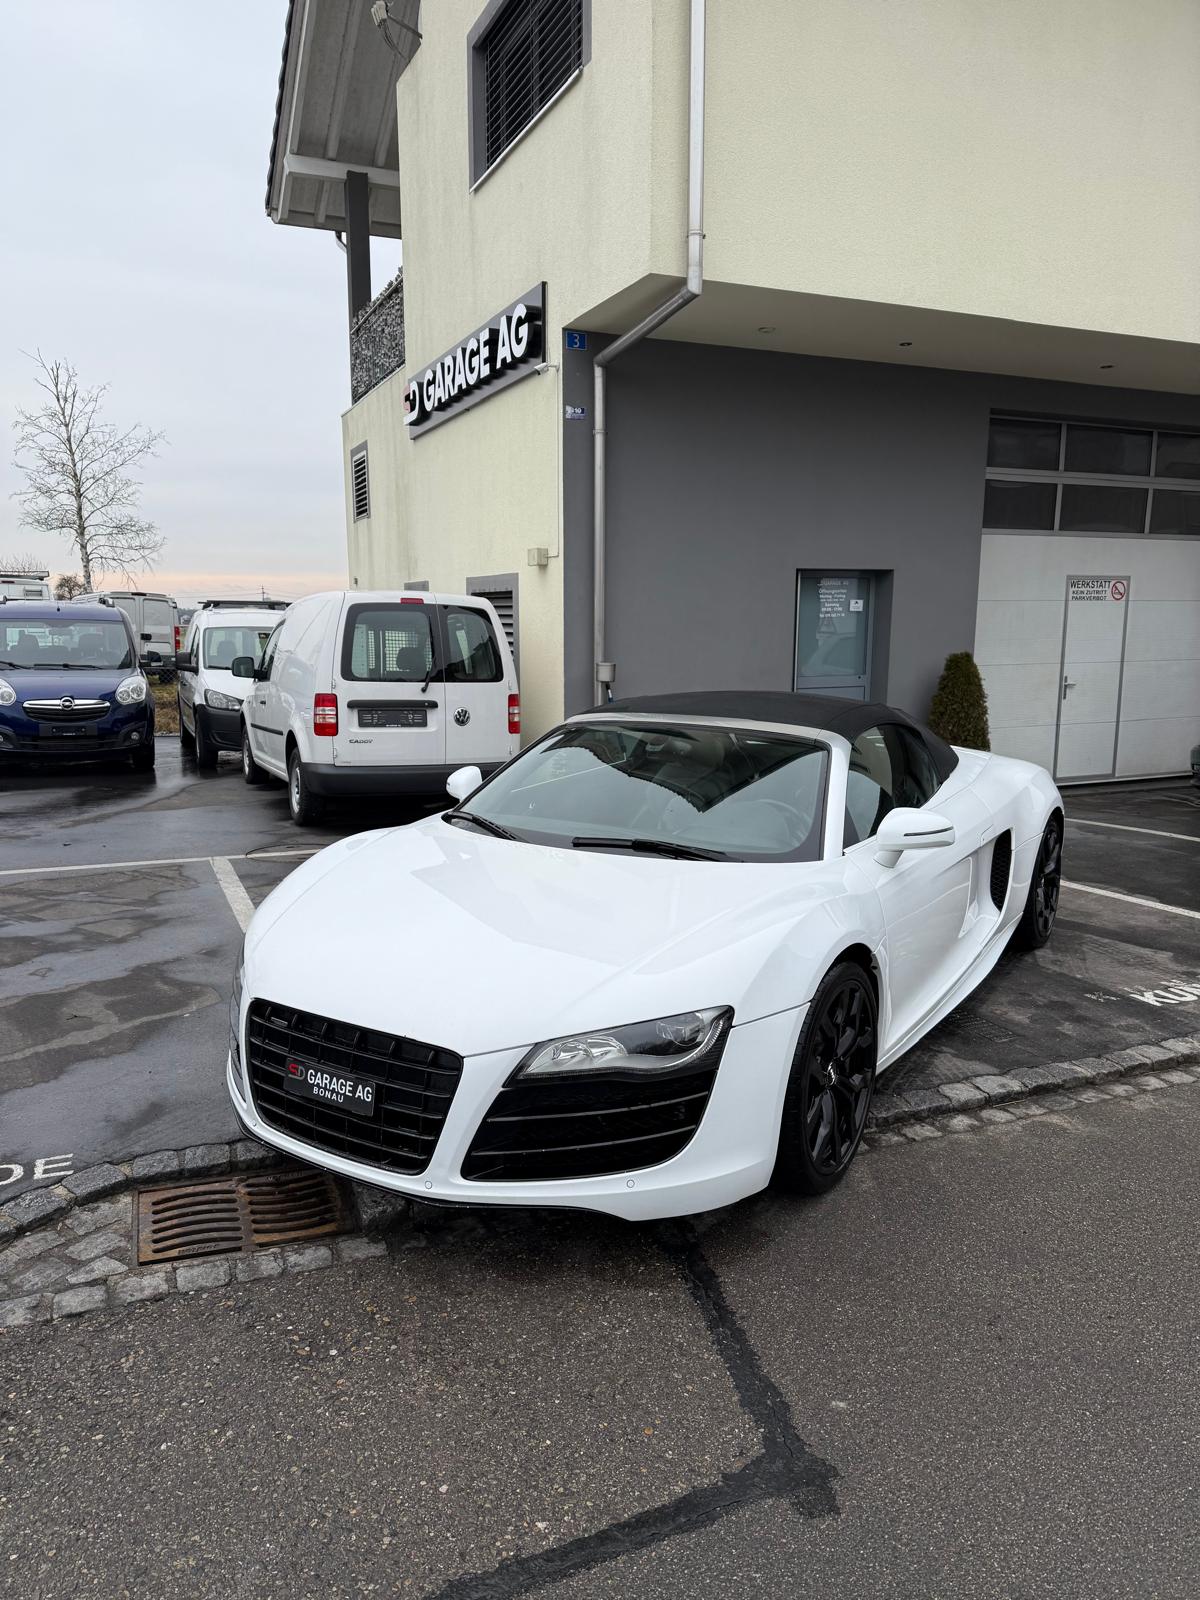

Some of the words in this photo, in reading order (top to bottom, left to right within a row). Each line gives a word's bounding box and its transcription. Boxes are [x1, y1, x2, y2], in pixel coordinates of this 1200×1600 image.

[572, 333, 580, 348] 3
[423, 328, 491, 412] GARAGE
[496, 303, 529, 370] AG
[1070, 580, 1111, 589] WERKSTATT
[307, 1069, 354, 1097] GARAGE
[355, 1084, 372, 1102] AG
[313, 1086, 344, 1103] BONAU
